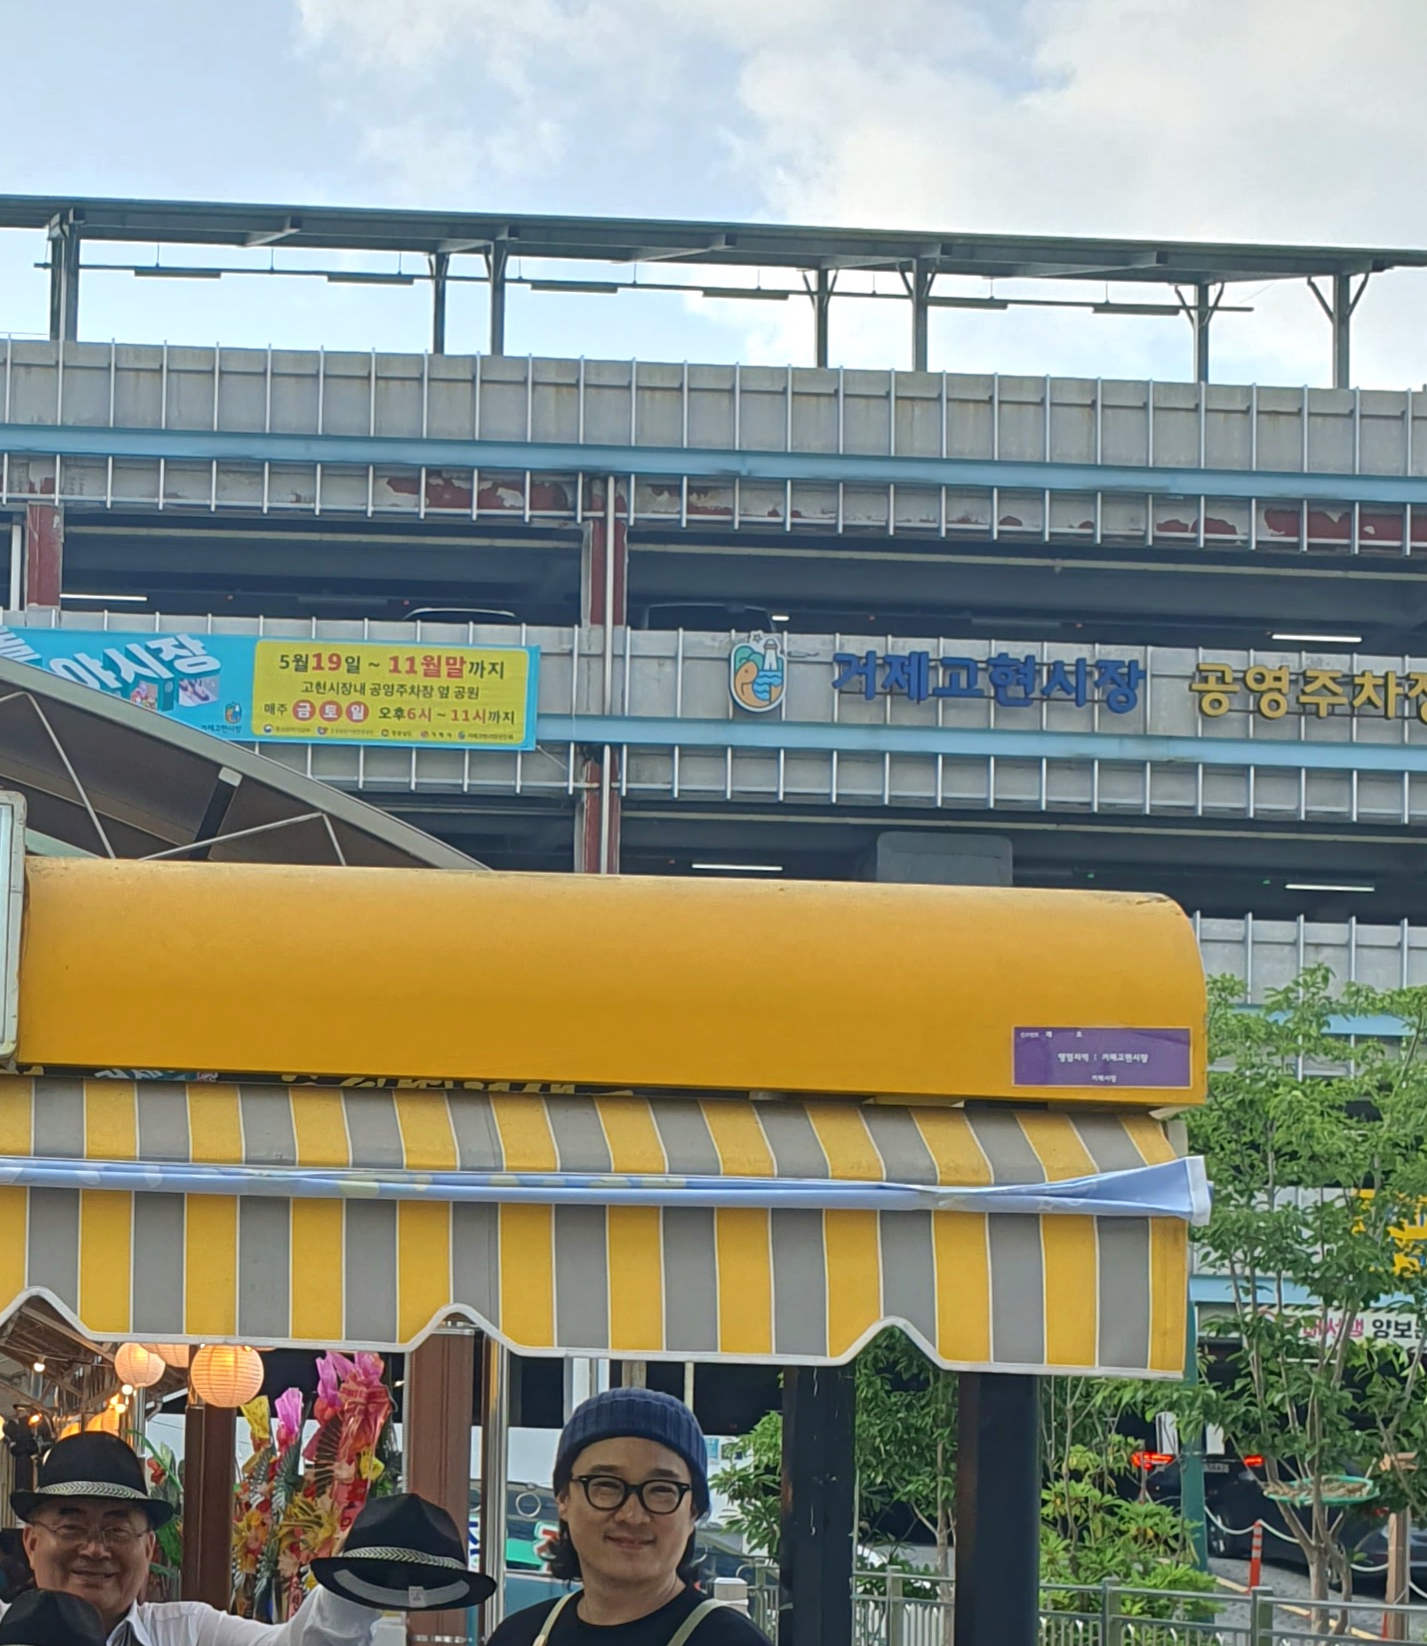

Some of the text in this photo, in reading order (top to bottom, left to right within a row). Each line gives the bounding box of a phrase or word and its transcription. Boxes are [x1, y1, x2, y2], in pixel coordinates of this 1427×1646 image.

[279, 652, 361, 675] 5월19일
[388, 655, 505, 680] 11월말까지
[370, 681, 435, 697] 공영주차장
[831, 649, 1146, 714] 거제고현시장
[263, 703, 288, 717] 매주
[296, 702, 313, 718] 금
[323, 703, 339, 719] 토
[350, 704, 365, 720] 일
[378, 706, 432, 722] 오후6시
[450, 708, 515, 725] 11시까지
